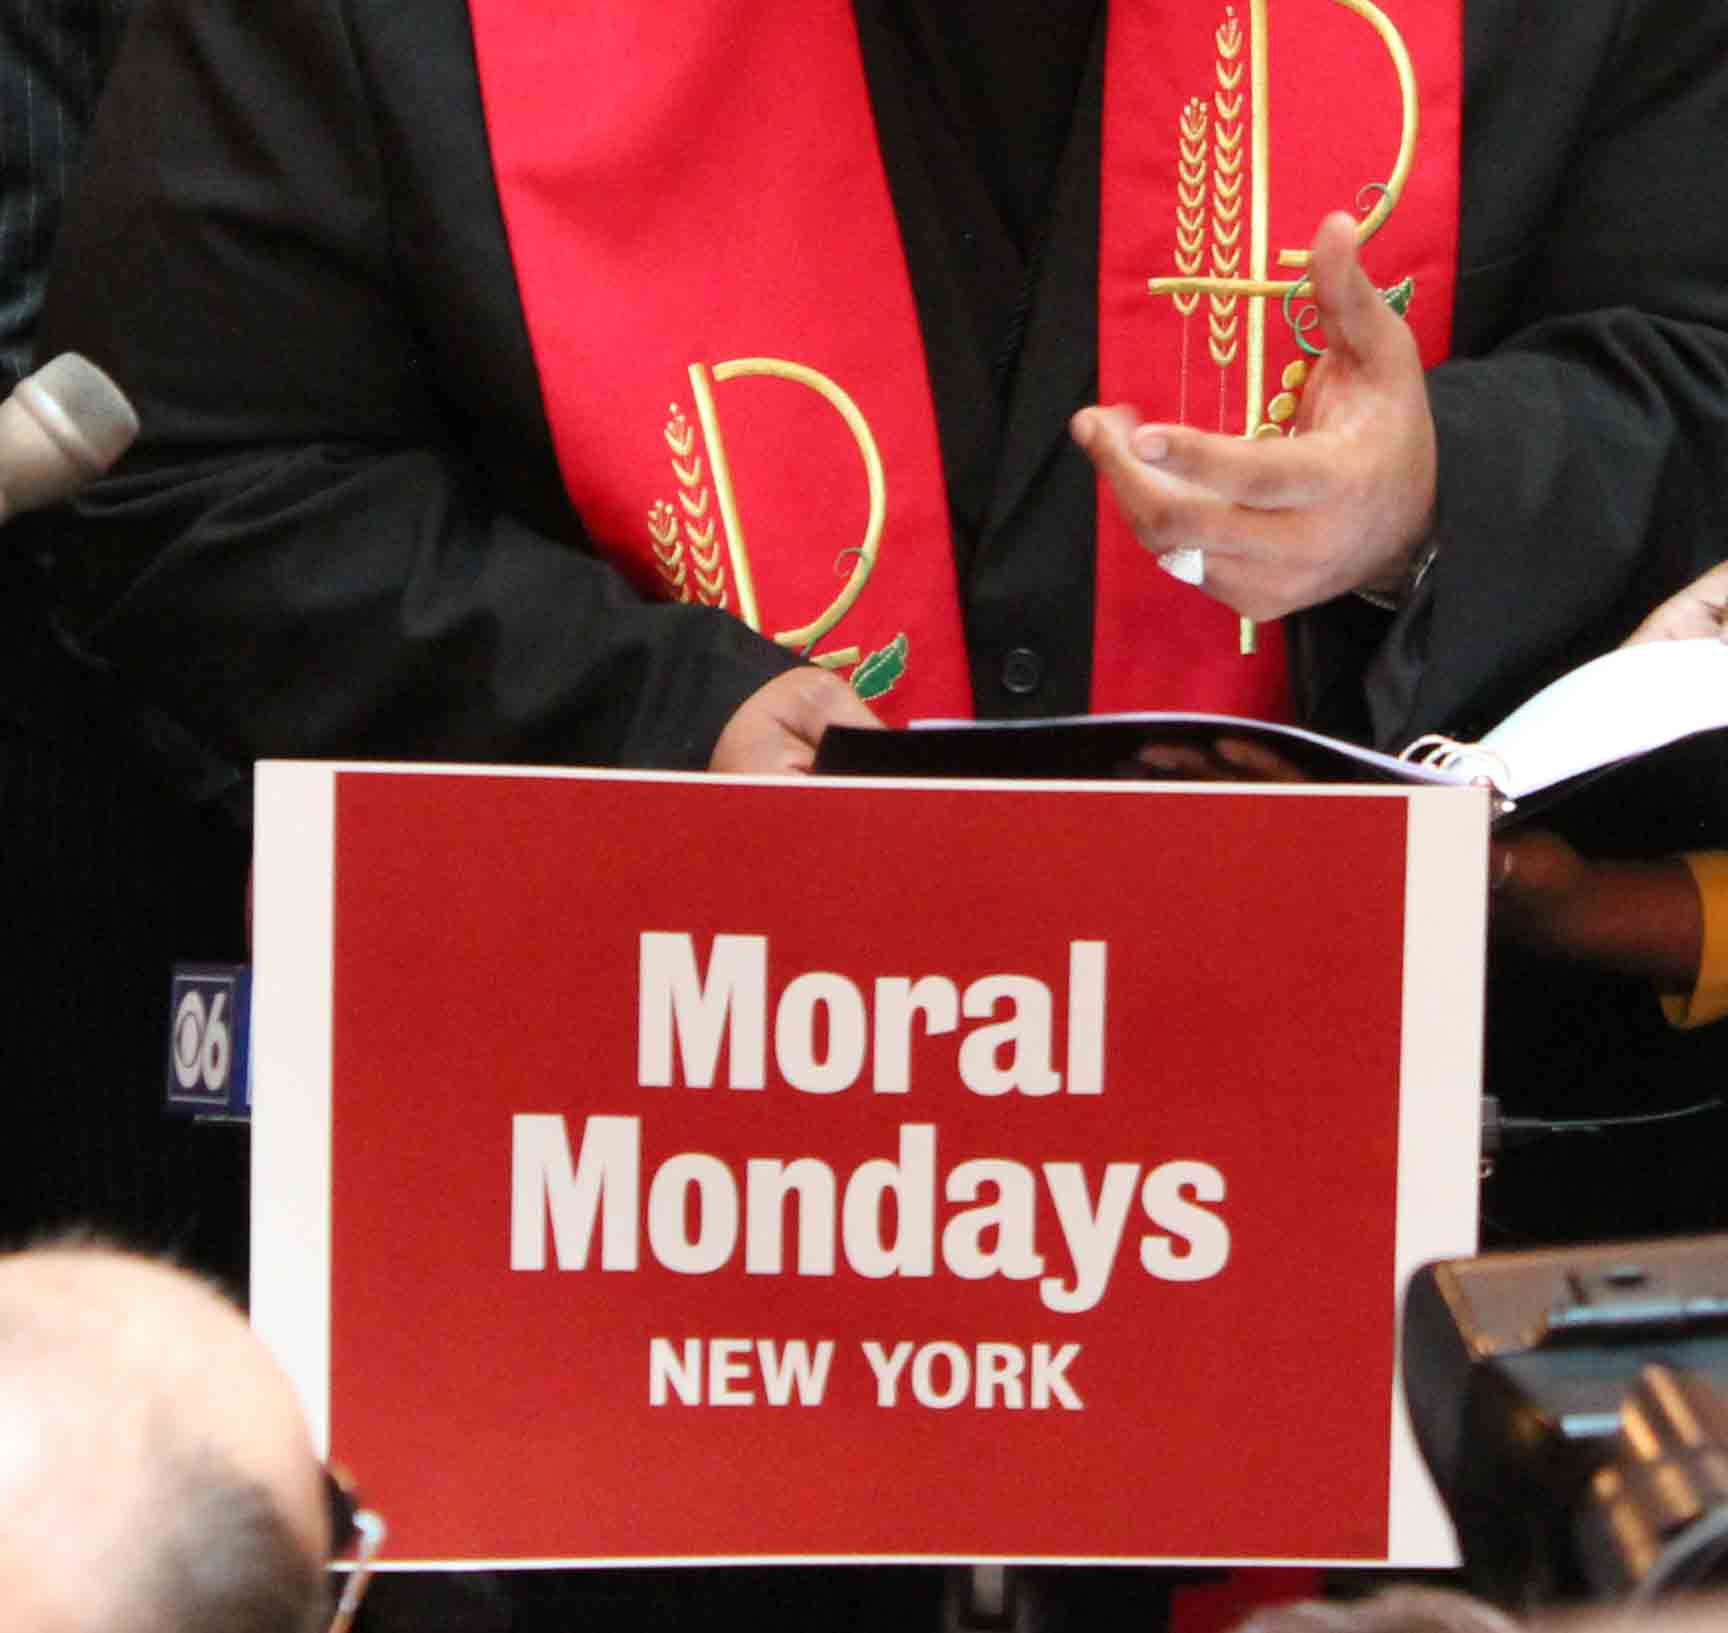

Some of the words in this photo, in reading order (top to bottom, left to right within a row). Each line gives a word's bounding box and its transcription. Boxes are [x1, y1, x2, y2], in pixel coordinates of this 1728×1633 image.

[637, 931, 1108, 1096] Moral
[509, 1112, 1231, 1314] Mondays
[648, 1337, 834, 1407] NEW
[861, 1341, 1084, 1411] YORK
